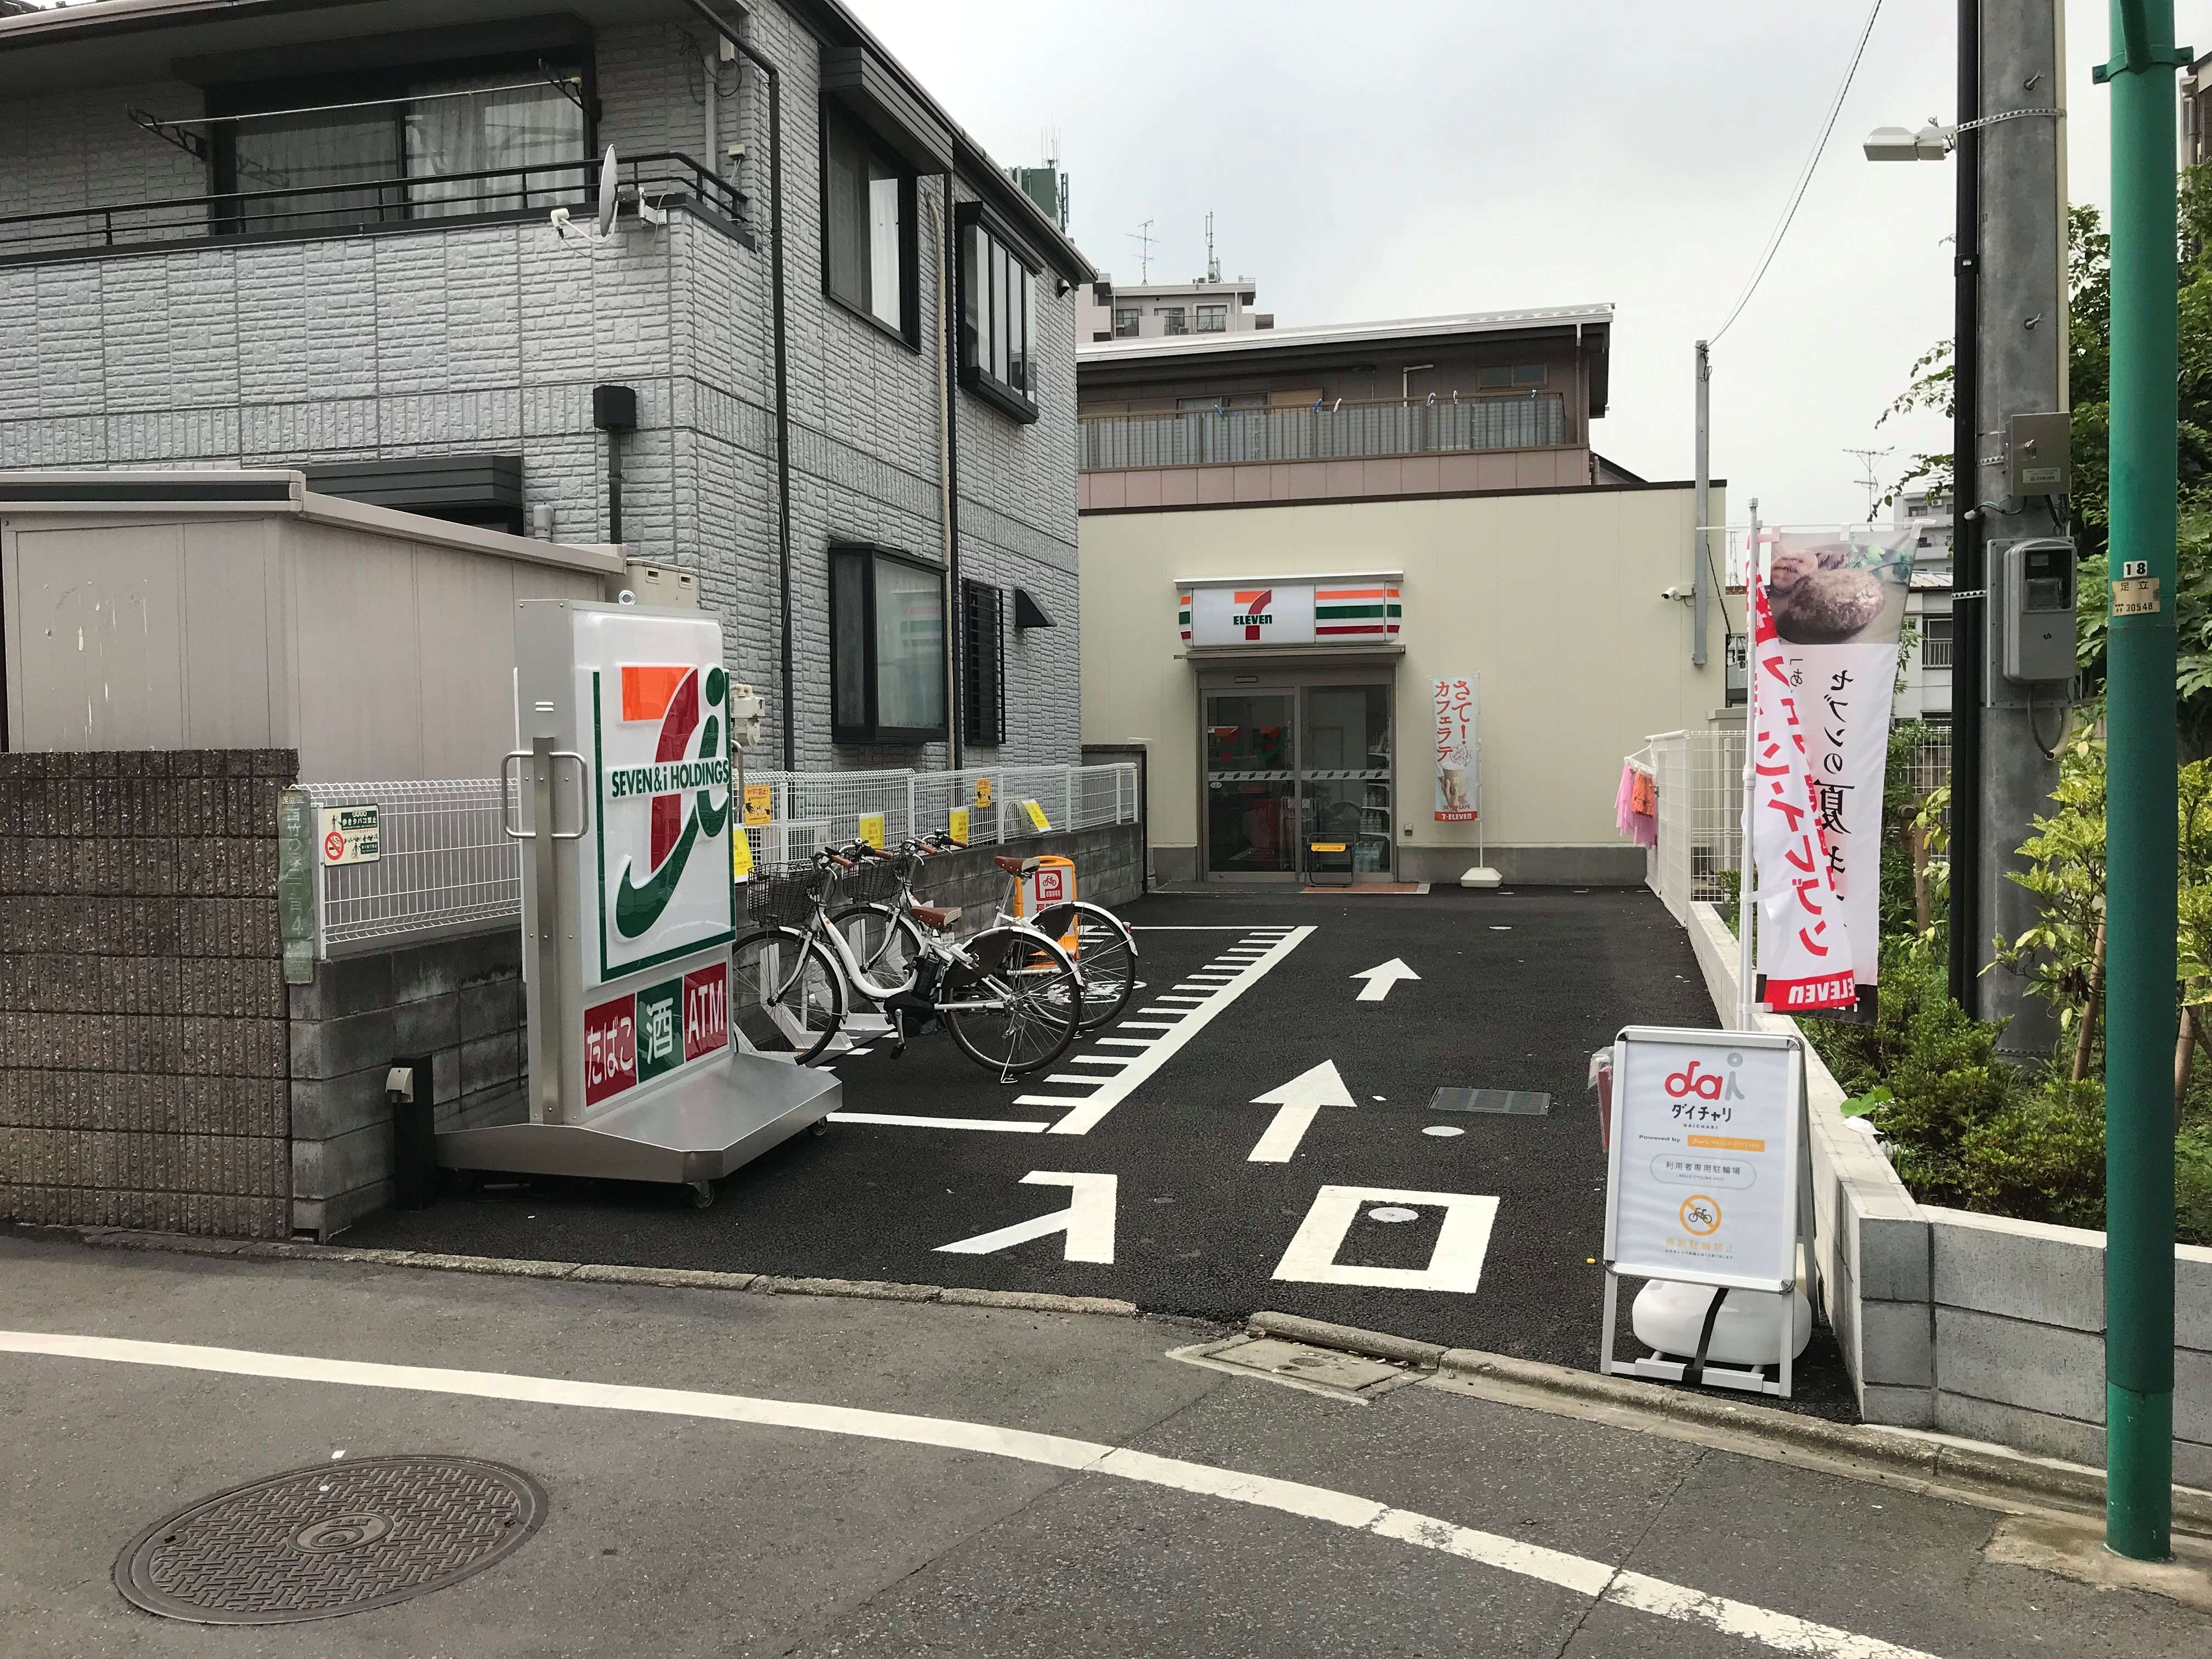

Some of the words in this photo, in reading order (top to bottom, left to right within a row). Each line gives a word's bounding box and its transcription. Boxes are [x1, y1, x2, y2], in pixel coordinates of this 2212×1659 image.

[2126, 562, 2146, 575] 18
[2120, 580, 2149, 592] 足立
[2126, 602, 2153, 612] 30548
[1434, 681, 1453, 762] カフェラテ
[671, 760, 729, 789] HOLDINGS
[688, 979, 724, 1044] ATM
[646, 997, 674, 1065] 酒
[587, 1015, 633, 1088] たばこ
[1672, 1103, 1731, 1122] ダイチャリ
[1666, 1161, 1741, 1175] 利用者専用駐輪場
